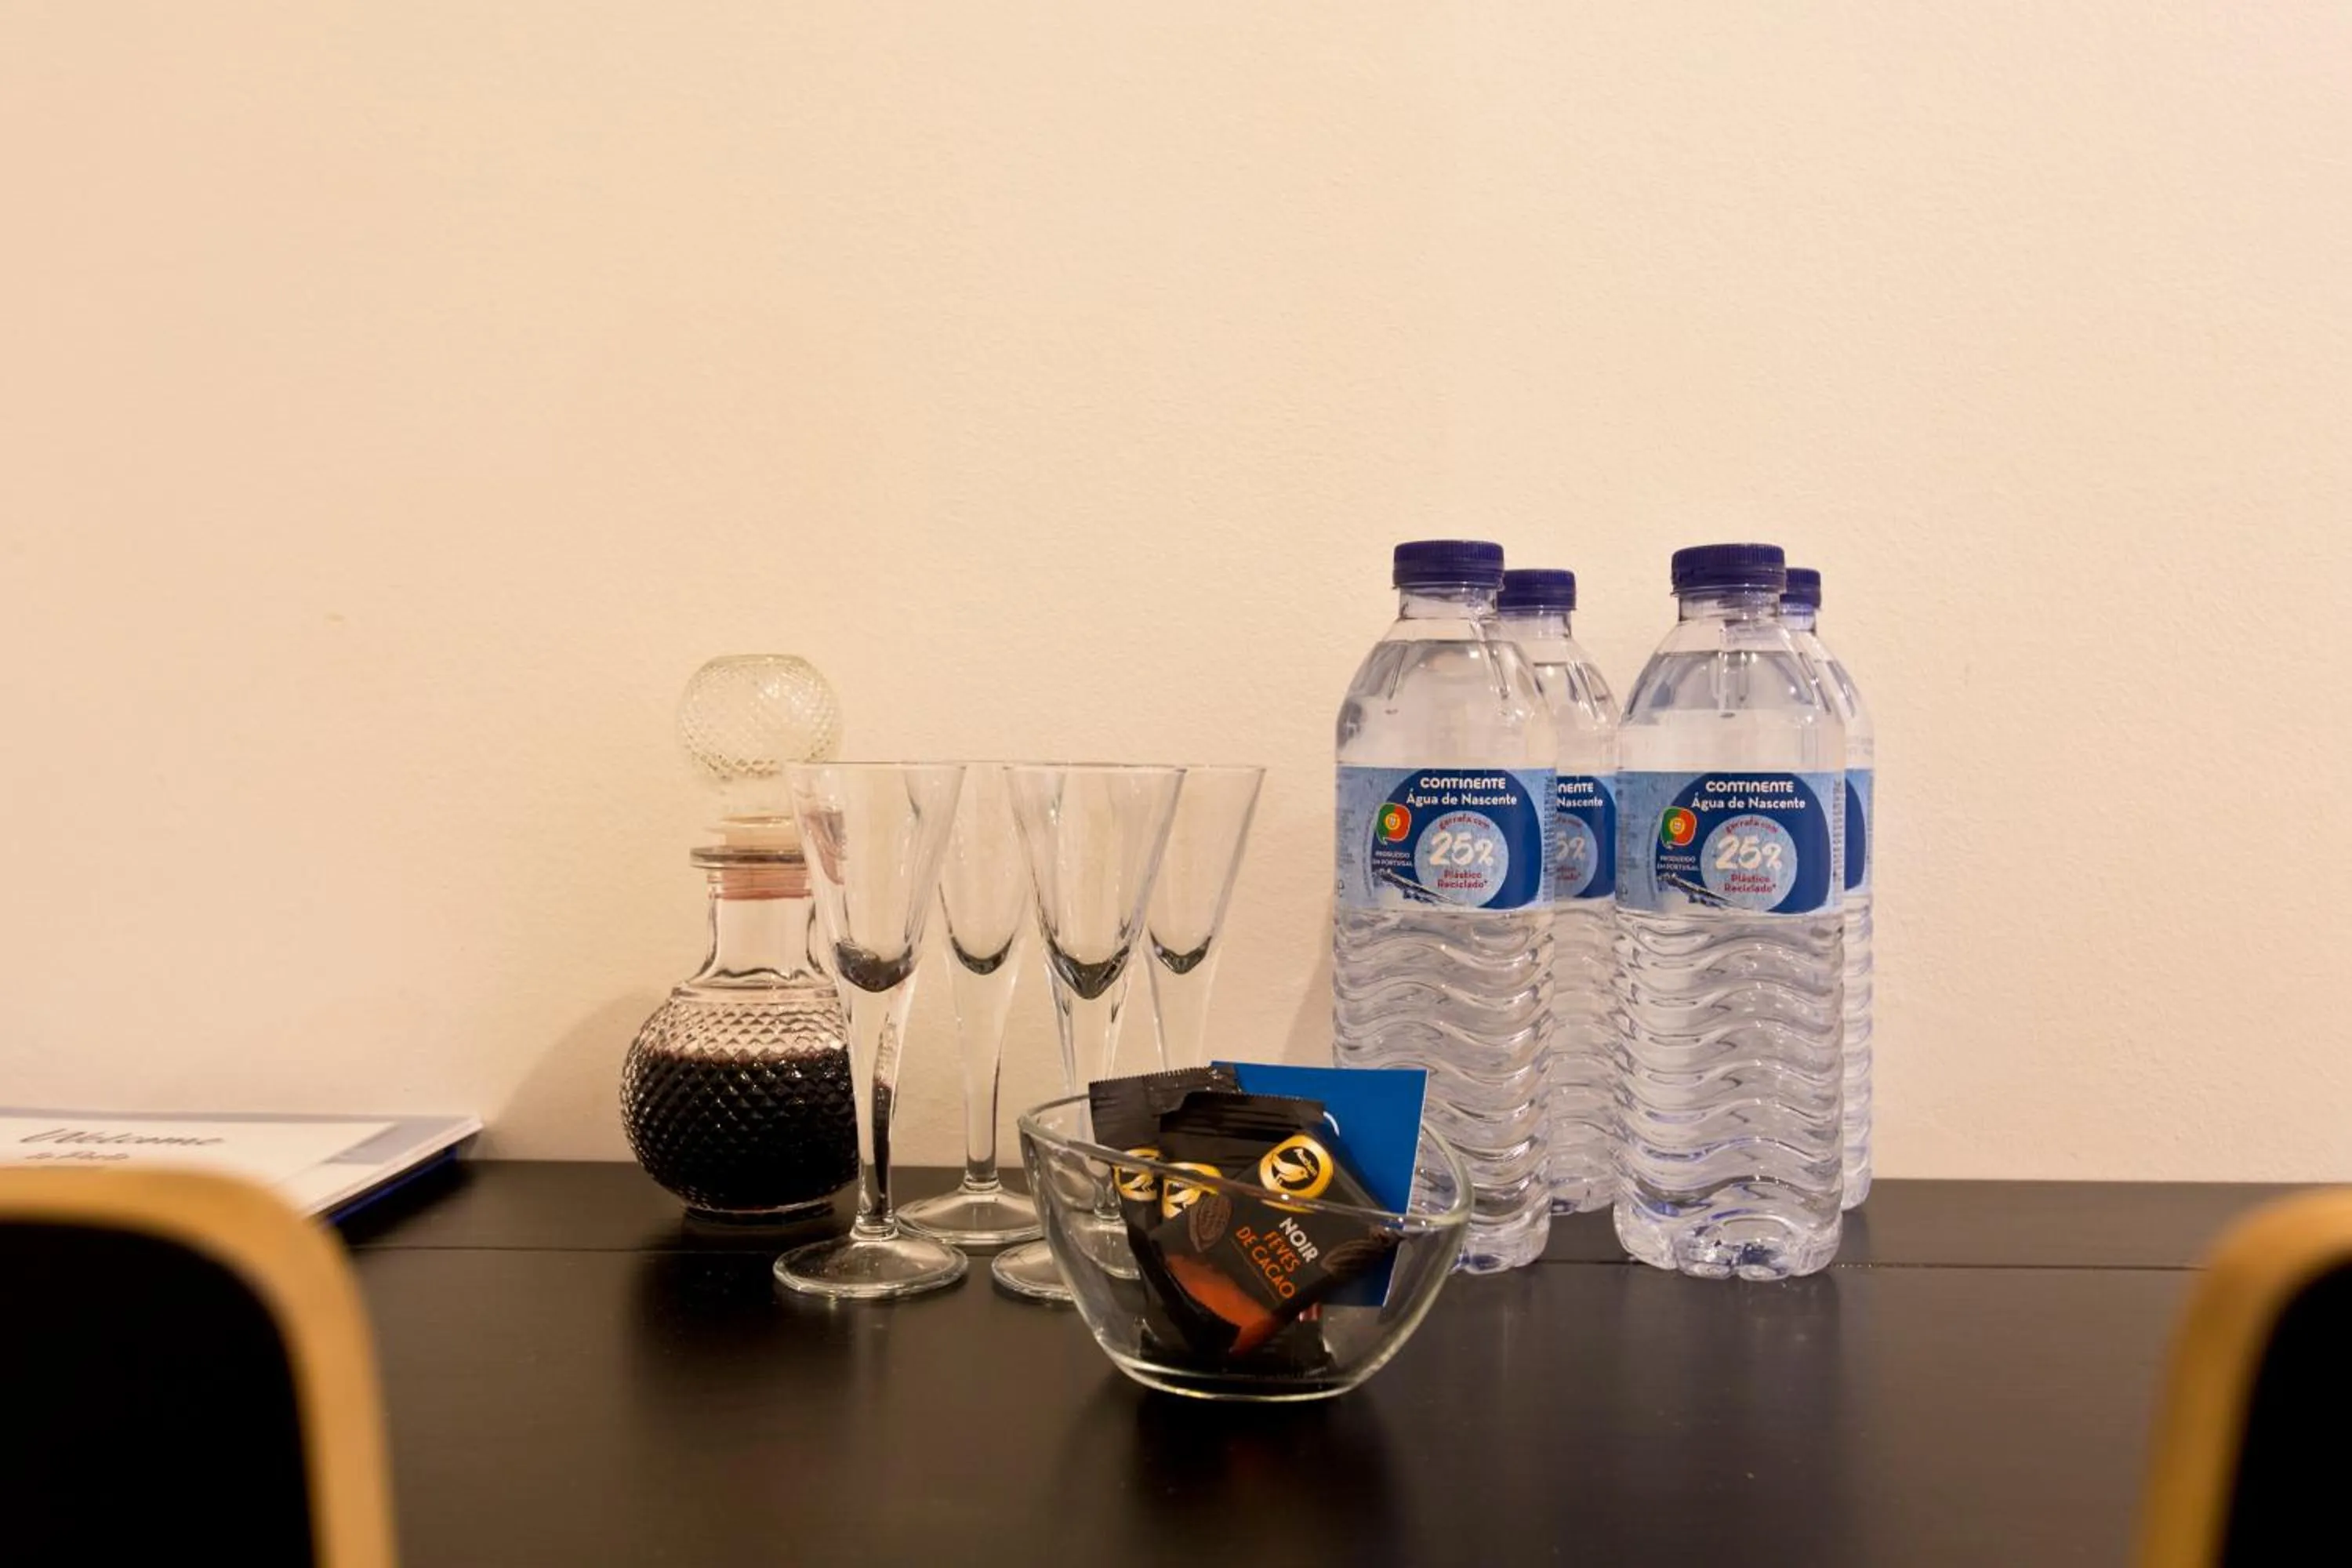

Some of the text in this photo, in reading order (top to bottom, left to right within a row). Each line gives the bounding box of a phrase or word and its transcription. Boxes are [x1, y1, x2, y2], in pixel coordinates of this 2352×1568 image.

[1420, 777, 1506, 789] CONTINENTE
[1558, 782, 1594, 793] NENTE
[1705, 781, 1795, 793] CONTINENTE
[1406, 787, 1518, 807] Água de Nascente
[1556, 797, 1604, 808] Nascente
[1691, 791, 1806, 811] Água de Nascente
[1428, 830, 1494, 866] 25%
[1715, 833, 1783, 870] 25%
[1279, 1217, 1319, 1263] NOIR
[1236, 1226, 1295, 1299] DE CACAO
